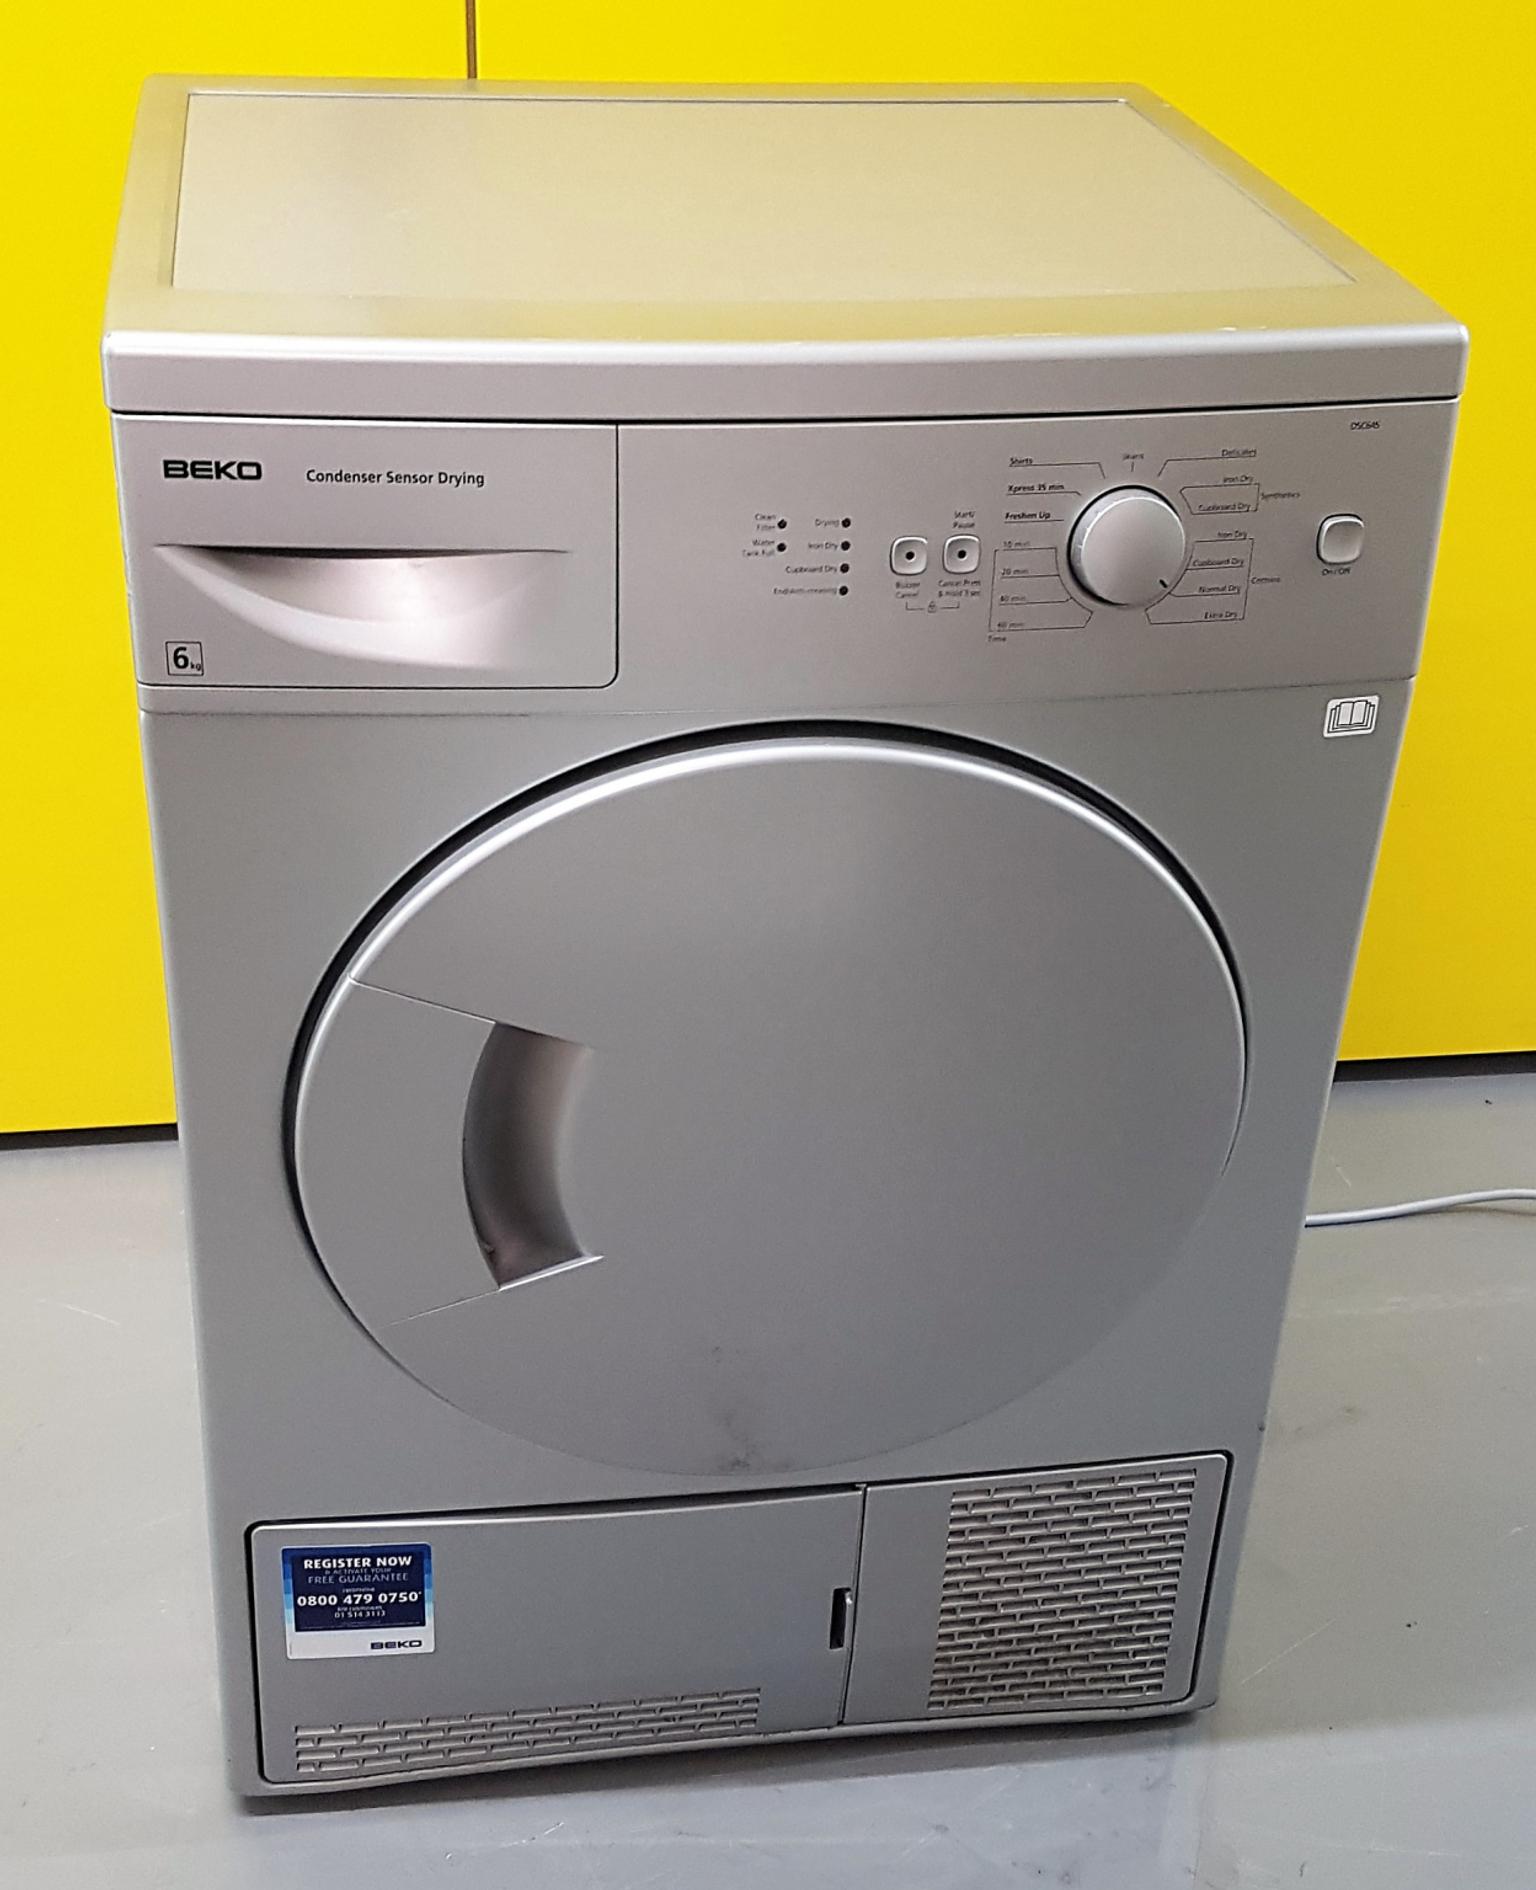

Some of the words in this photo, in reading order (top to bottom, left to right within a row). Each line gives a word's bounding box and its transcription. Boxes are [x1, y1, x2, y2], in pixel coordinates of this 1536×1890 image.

[163, 459, 263, 481] BEKO
[306, 469, 383, 484] Condenser
[386, 471, 434, 485] Sensor
[438, 471, 485, 488] Drying
[1004, 512, 1037, 520] Freshen
[1039, 512, 1051, 522] Up
[1235, 530, 1248, 539] Dry
[1231, 556, 1244, 566] Dry
[1230, 583, 1241, 593] Dry
[173, 647, 189, 669] 6
[304, 1558, 371, 1569] REGISTER
[376, 1556, 412, 1567] NOW
[308, 1575, 335, 1584] FREE
[339, 1573, 408, 1583] GUARANTEE
[297, 1595, 338, 1607] 0800
[343, 1594, 373, 1604] 479
[371, 1640, 422, 1650] BEKO
